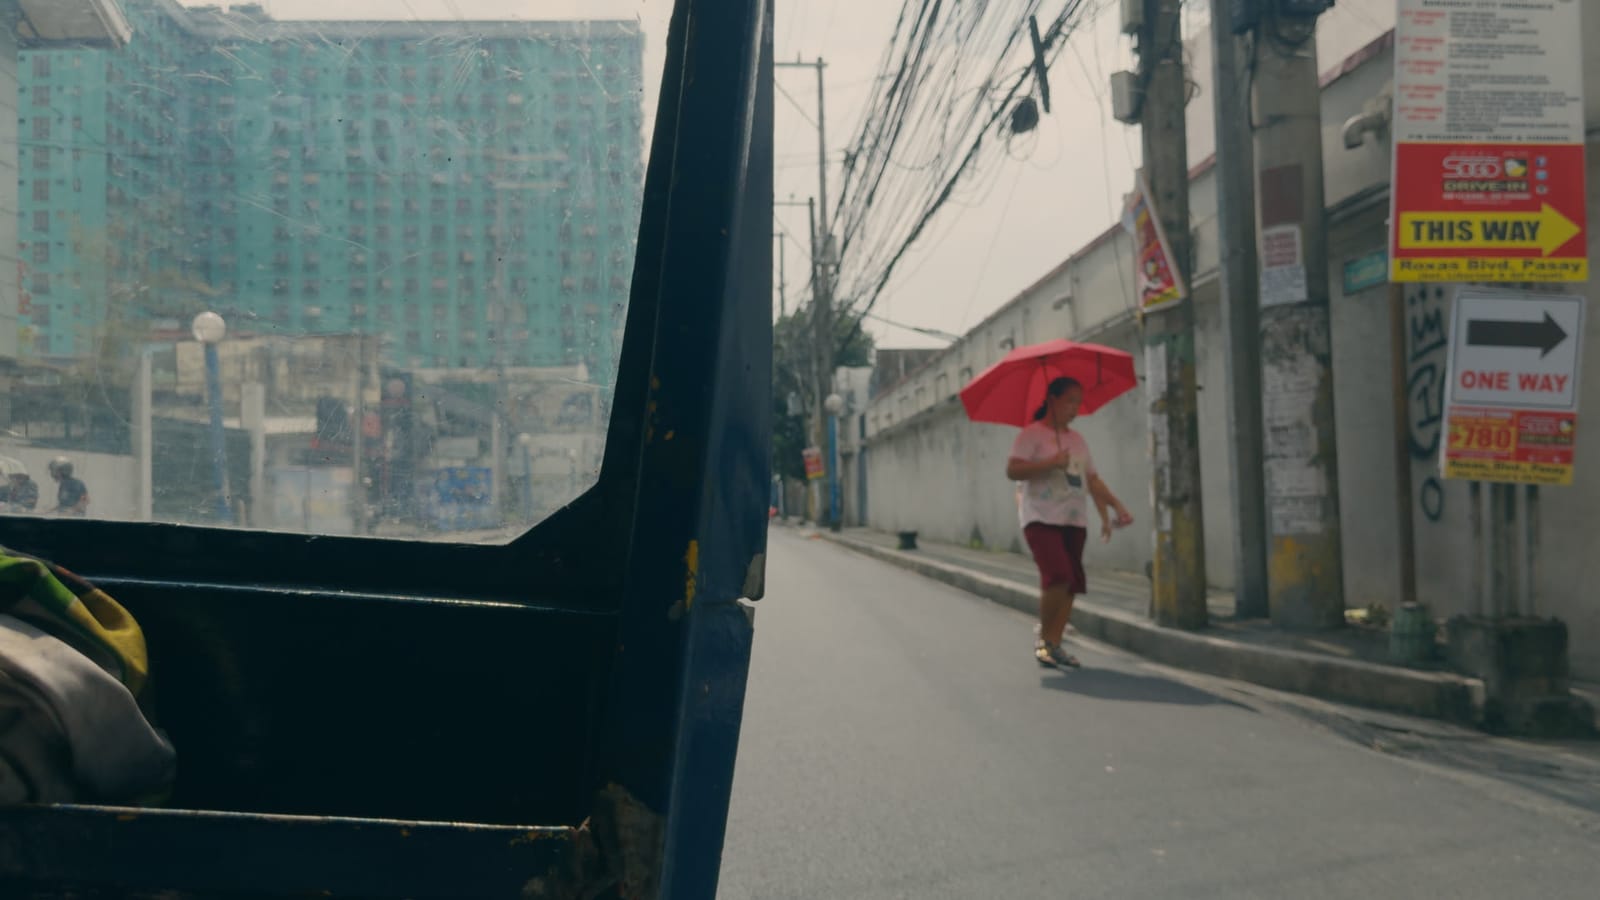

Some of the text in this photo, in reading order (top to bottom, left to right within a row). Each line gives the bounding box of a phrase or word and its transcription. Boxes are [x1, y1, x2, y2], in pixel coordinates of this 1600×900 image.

[1443, 180, 1528, 192] DRIVE-IN
[1410, 220, 1541, 242] THIS WAY
[1399, 259, 1460, 271] Roxas
[1522, 260, 1582, 272] Pasay
[1461, 371, 1567, 392] ONE WAY
